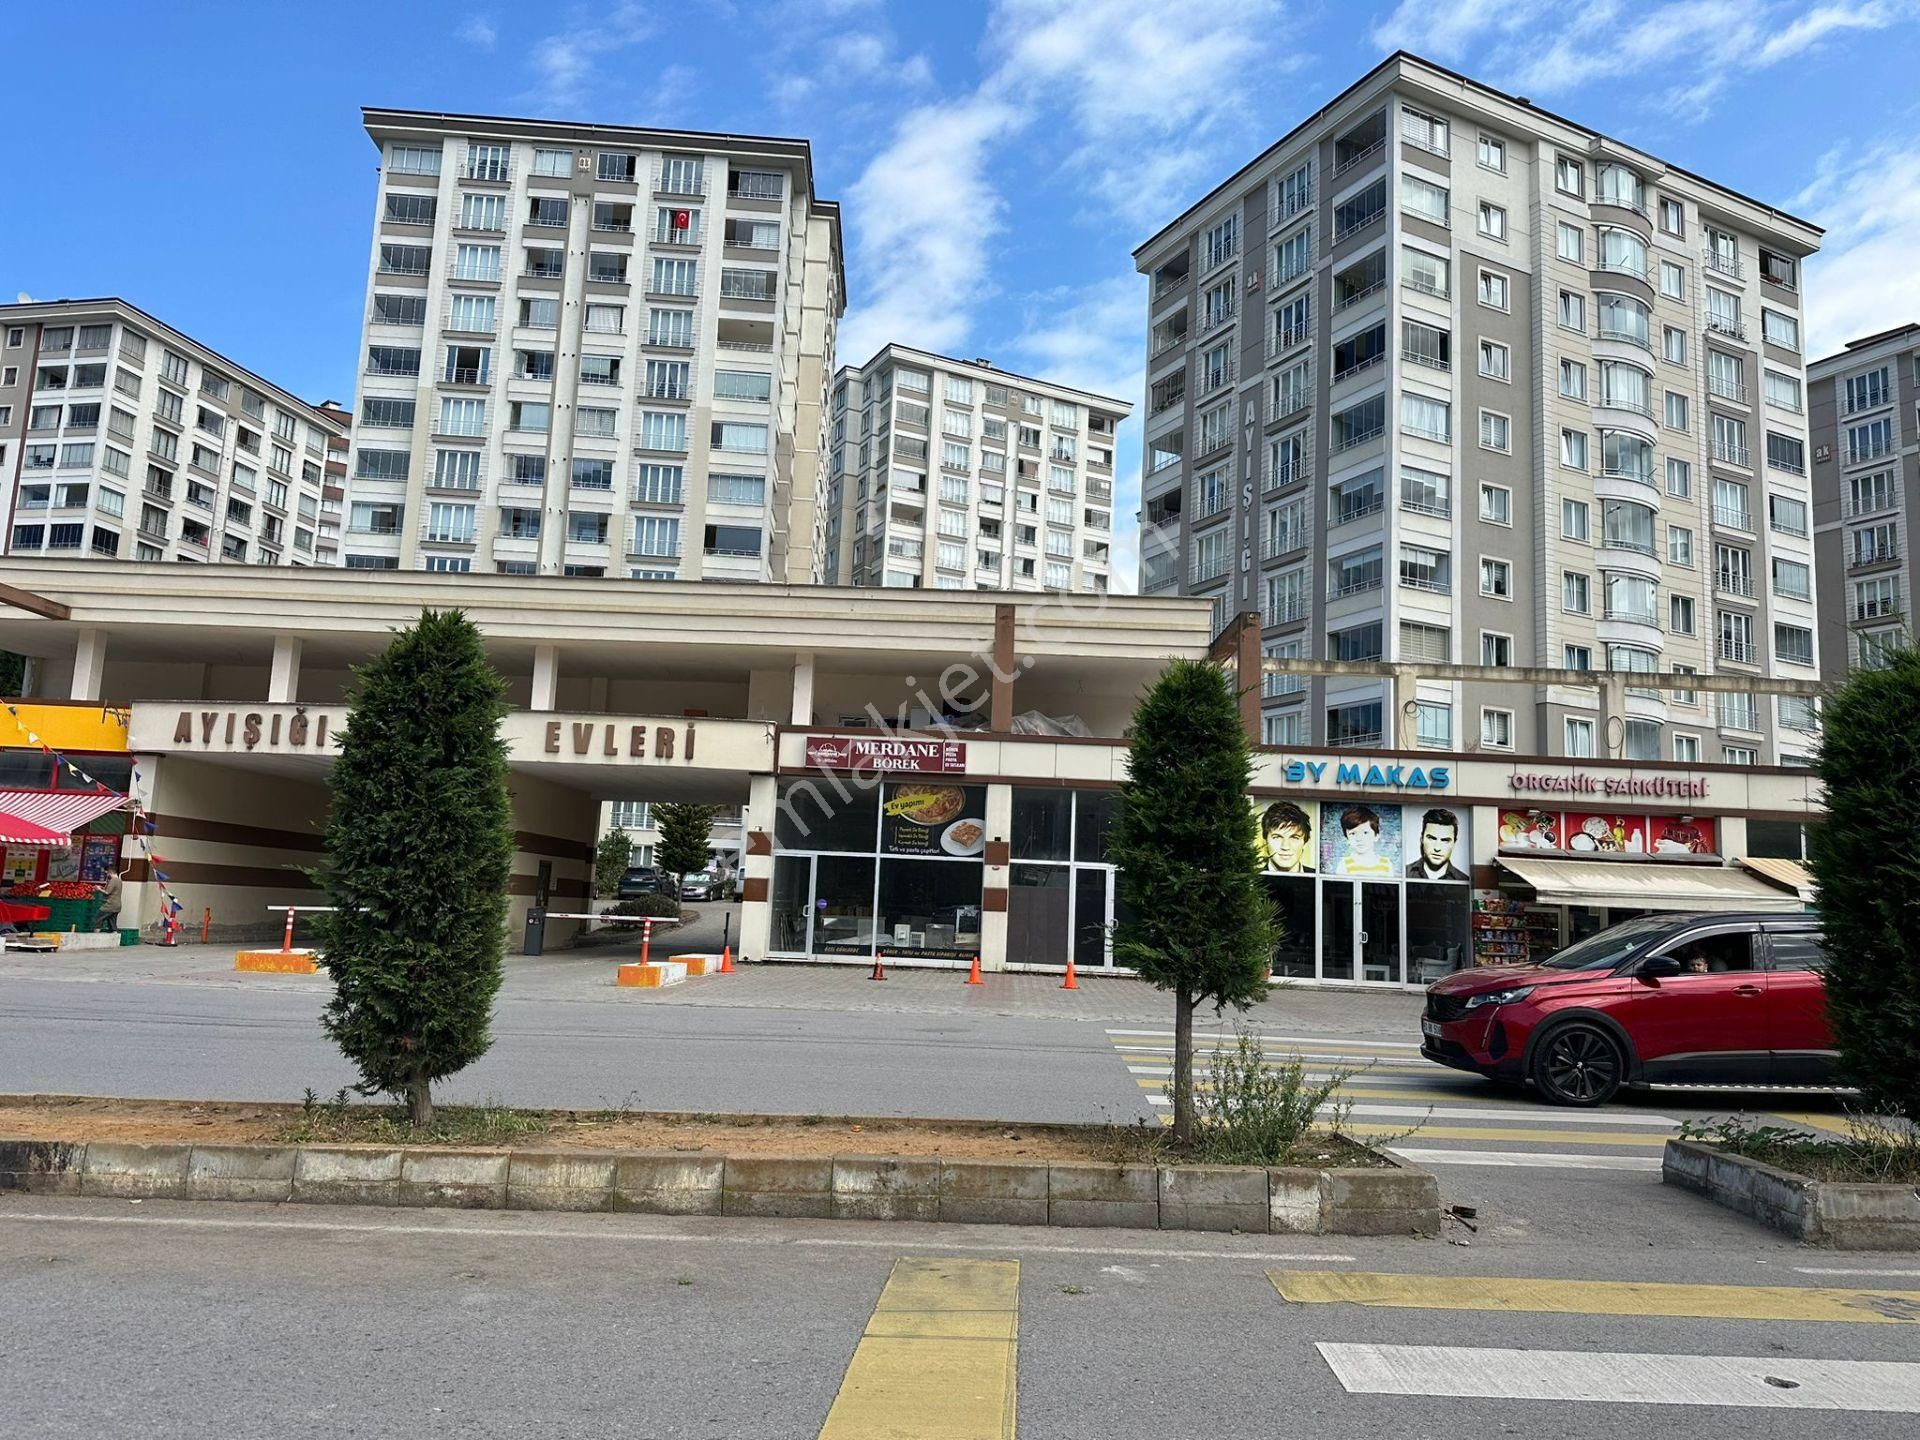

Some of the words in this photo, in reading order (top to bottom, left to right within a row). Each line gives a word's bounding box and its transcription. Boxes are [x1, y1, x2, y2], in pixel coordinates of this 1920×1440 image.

[1241, 400, 1255, 601] AYIŞIĞI
[173, 707, 328, 749] AYIŞIĞI
[545, 721, 696, 760] EVLERİ
[855, 741, 939, 757] MERDANE
[873, 757, 920, 770] BÖREK
[1286, 761, 1327, 782] BY
[1336, 763, 1450, 788] MAKAS
[1511, 773, 1598, 793] ORGANİK
[1604, 776, 1708, 798] ŞARKÜTERİ
[900, 800, 925, 810] yapımı
